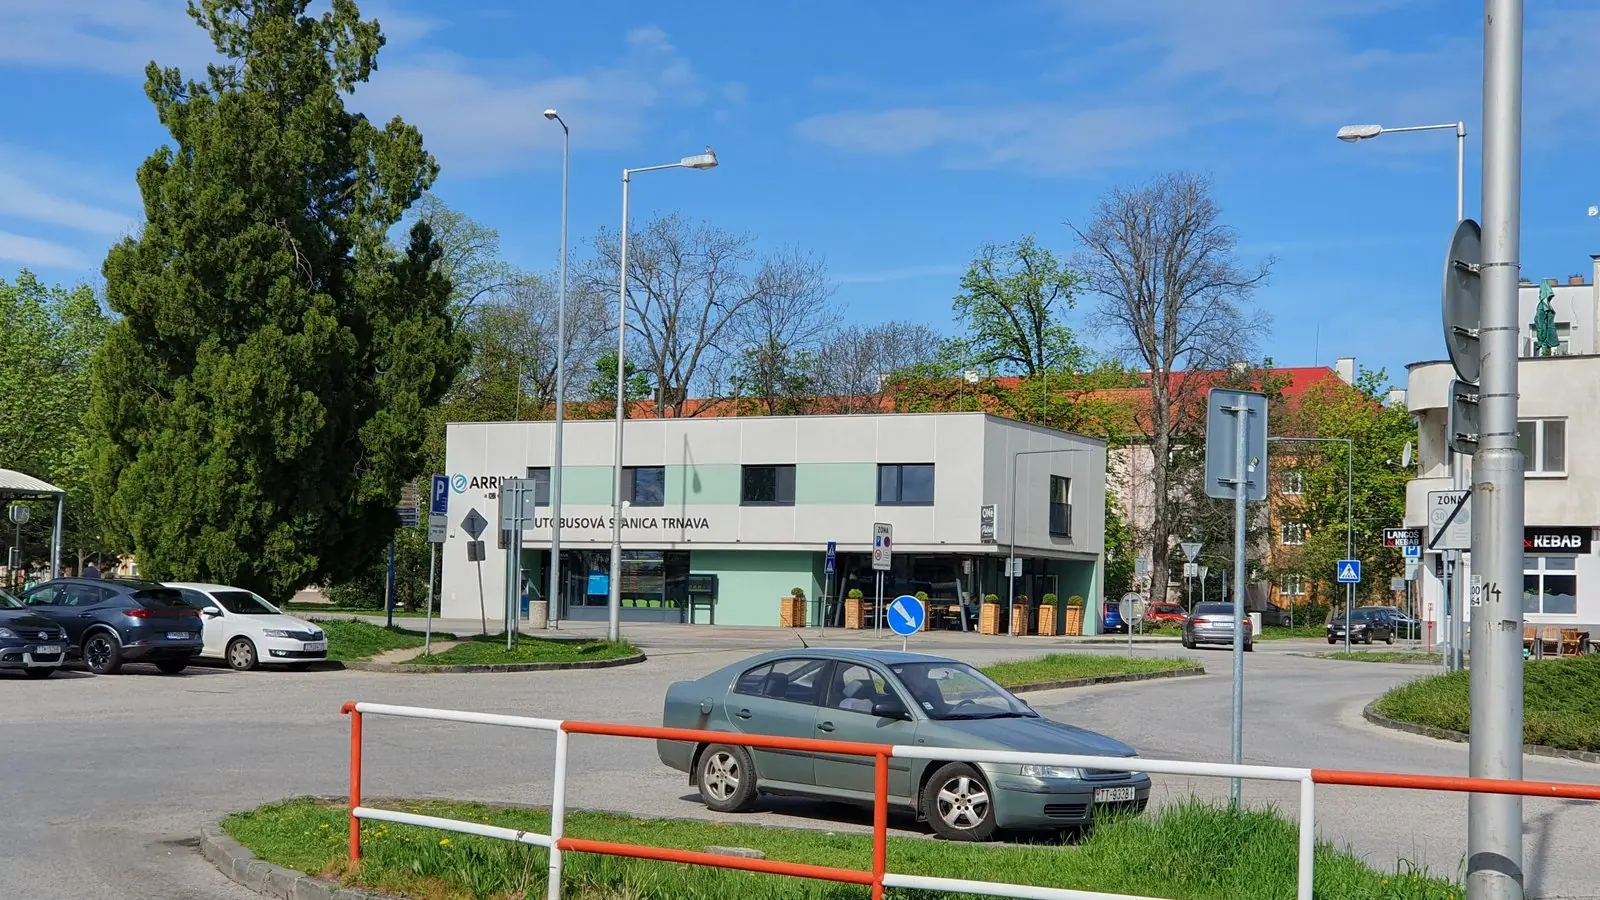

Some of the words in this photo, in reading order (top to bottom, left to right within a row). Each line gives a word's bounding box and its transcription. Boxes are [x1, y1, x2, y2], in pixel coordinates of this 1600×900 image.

[469, 476, 518, 489] ARRI
[436, 480, 445, 501] P
[1434, 512, 1445, 521] 30
[609, 517, 658, 529] SANICA
[662, 517, 710, 529] TRNAVA
[1395, 538, 1420, 547] KEBAB
[1534, 534, 1582, 548] KEBAB
[1408, 546, 1416, 555] P
[1482, 582, 1502, 603] 14
